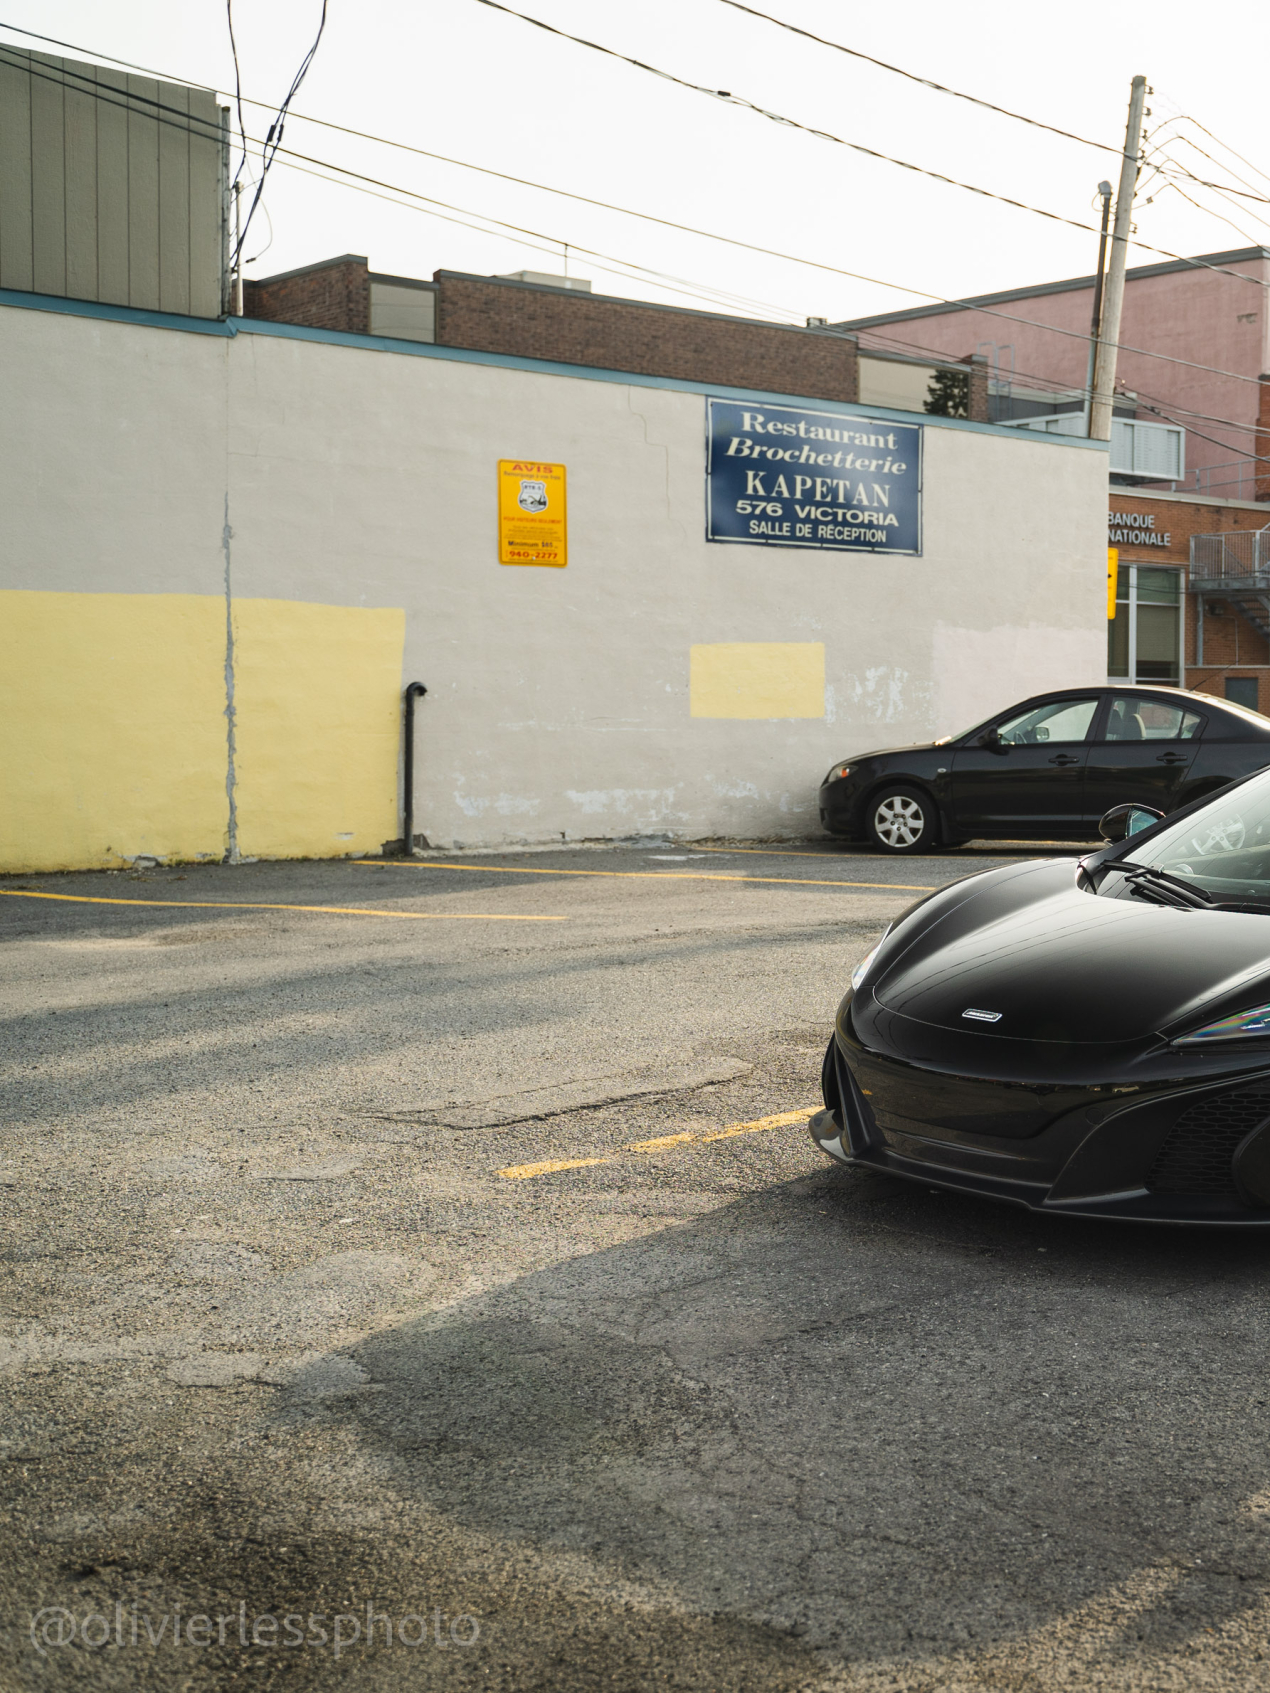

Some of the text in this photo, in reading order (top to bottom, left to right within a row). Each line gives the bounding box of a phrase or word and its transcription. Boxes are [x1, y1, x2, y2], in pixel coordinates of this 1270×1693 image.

[740, 411, 898, 450] Restaurant
[724, 437, 907, 475] Brochetterie
[512, 463, 553, 474] AVIS
[745, 470, 892, 508] KAPETAN
[735, 499, 899, 527] 576 VICTORIA
[1108, 511, 1155, 528] BANQUE
[749, 520, 887, 543] SALLE DE RÉCEPTION
[1108, 529, 1171, 546] NATIONALE
[509, 550, 558, 560] 940-2277
